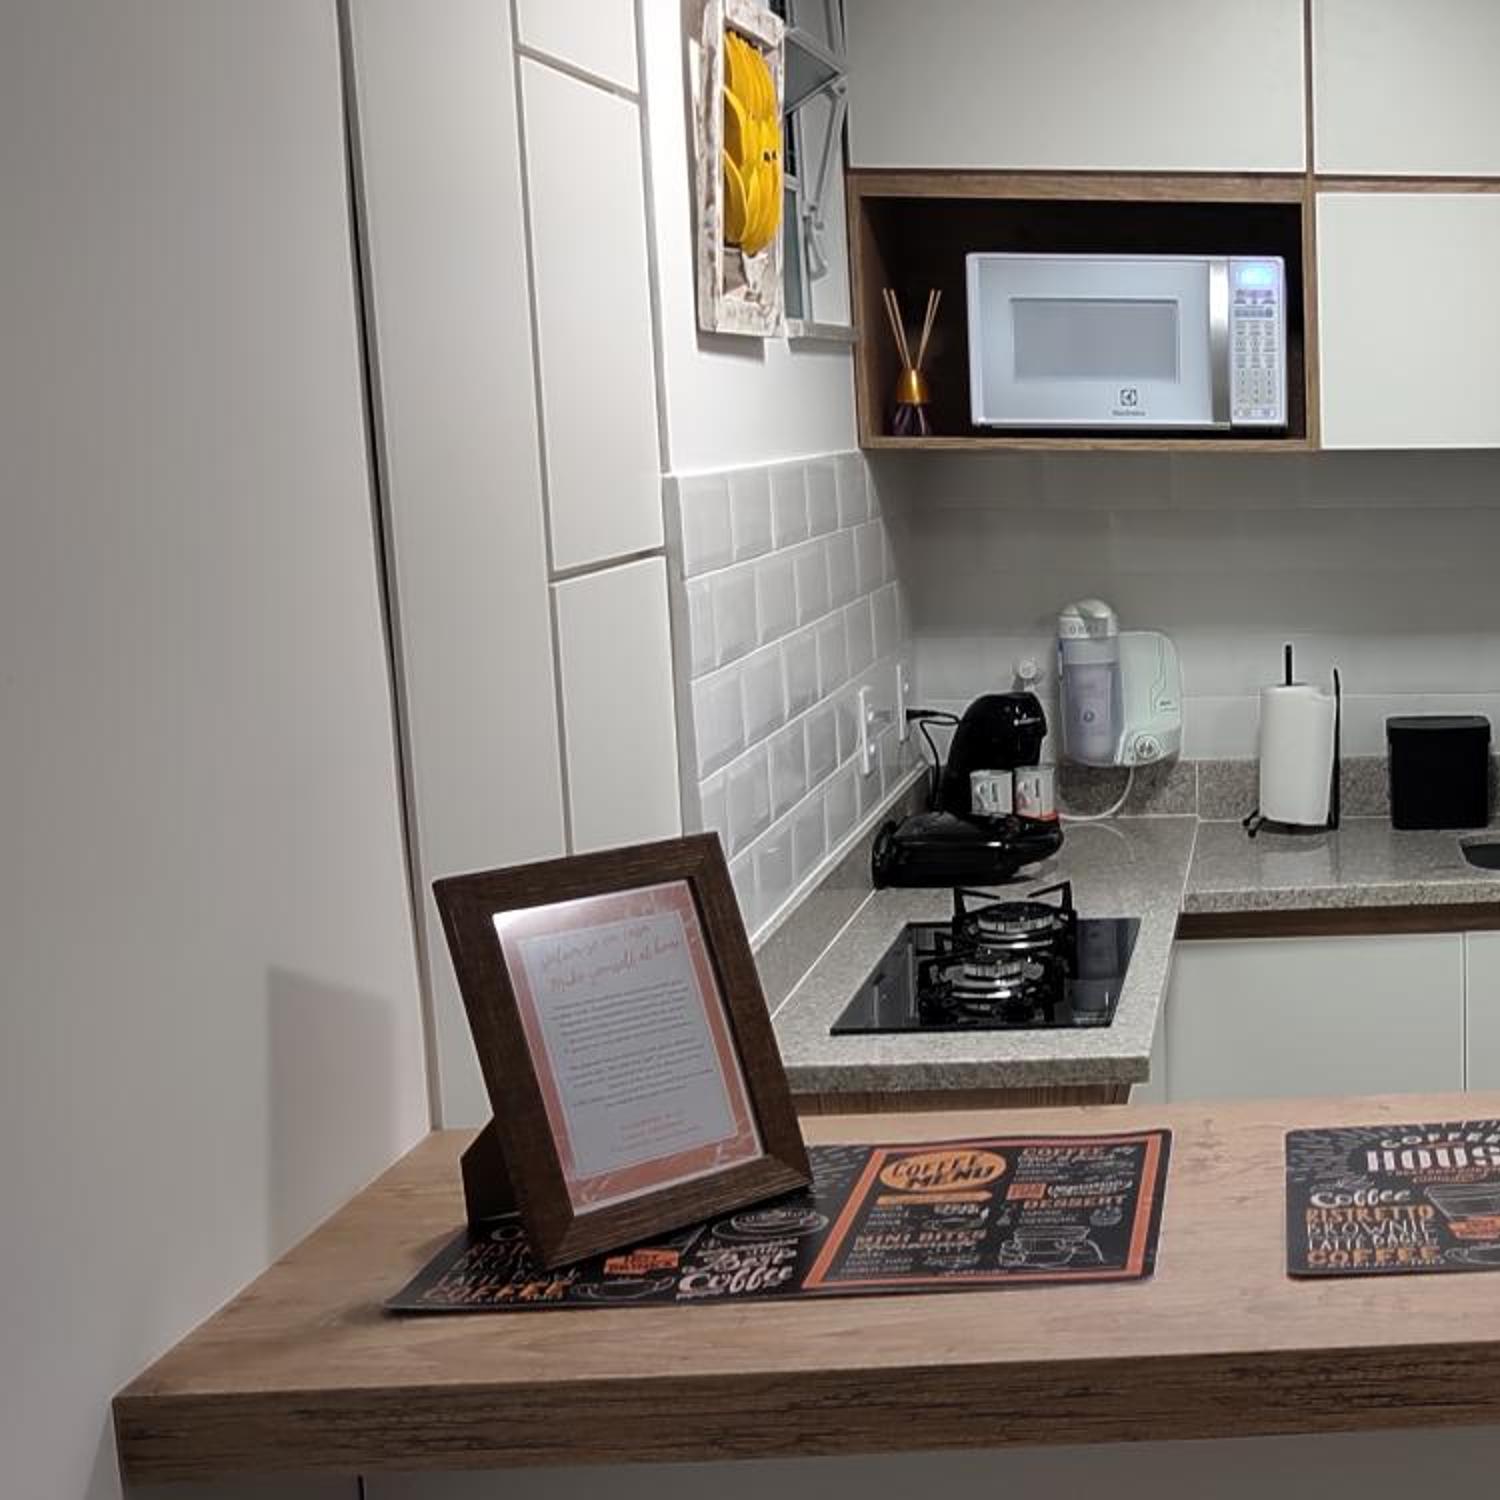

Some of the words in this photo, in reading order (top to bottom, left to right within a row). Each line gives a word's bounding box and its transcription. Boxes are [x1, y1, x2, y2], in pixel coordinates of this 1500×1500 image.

[891, 1155, 976, 1179] COFFEE
[907, 1165, 995, 1188] MENU
[1310, 1188, 1411, 1209] Coffee
[1306, 1204, 1434, 1223] RISTRETTO
[1307, 1218, 1437, 1236] BROWNIE
[1307, 1247, 1441, 1265] COFFEE
[679, 1266, 793, 1294] Coffee
